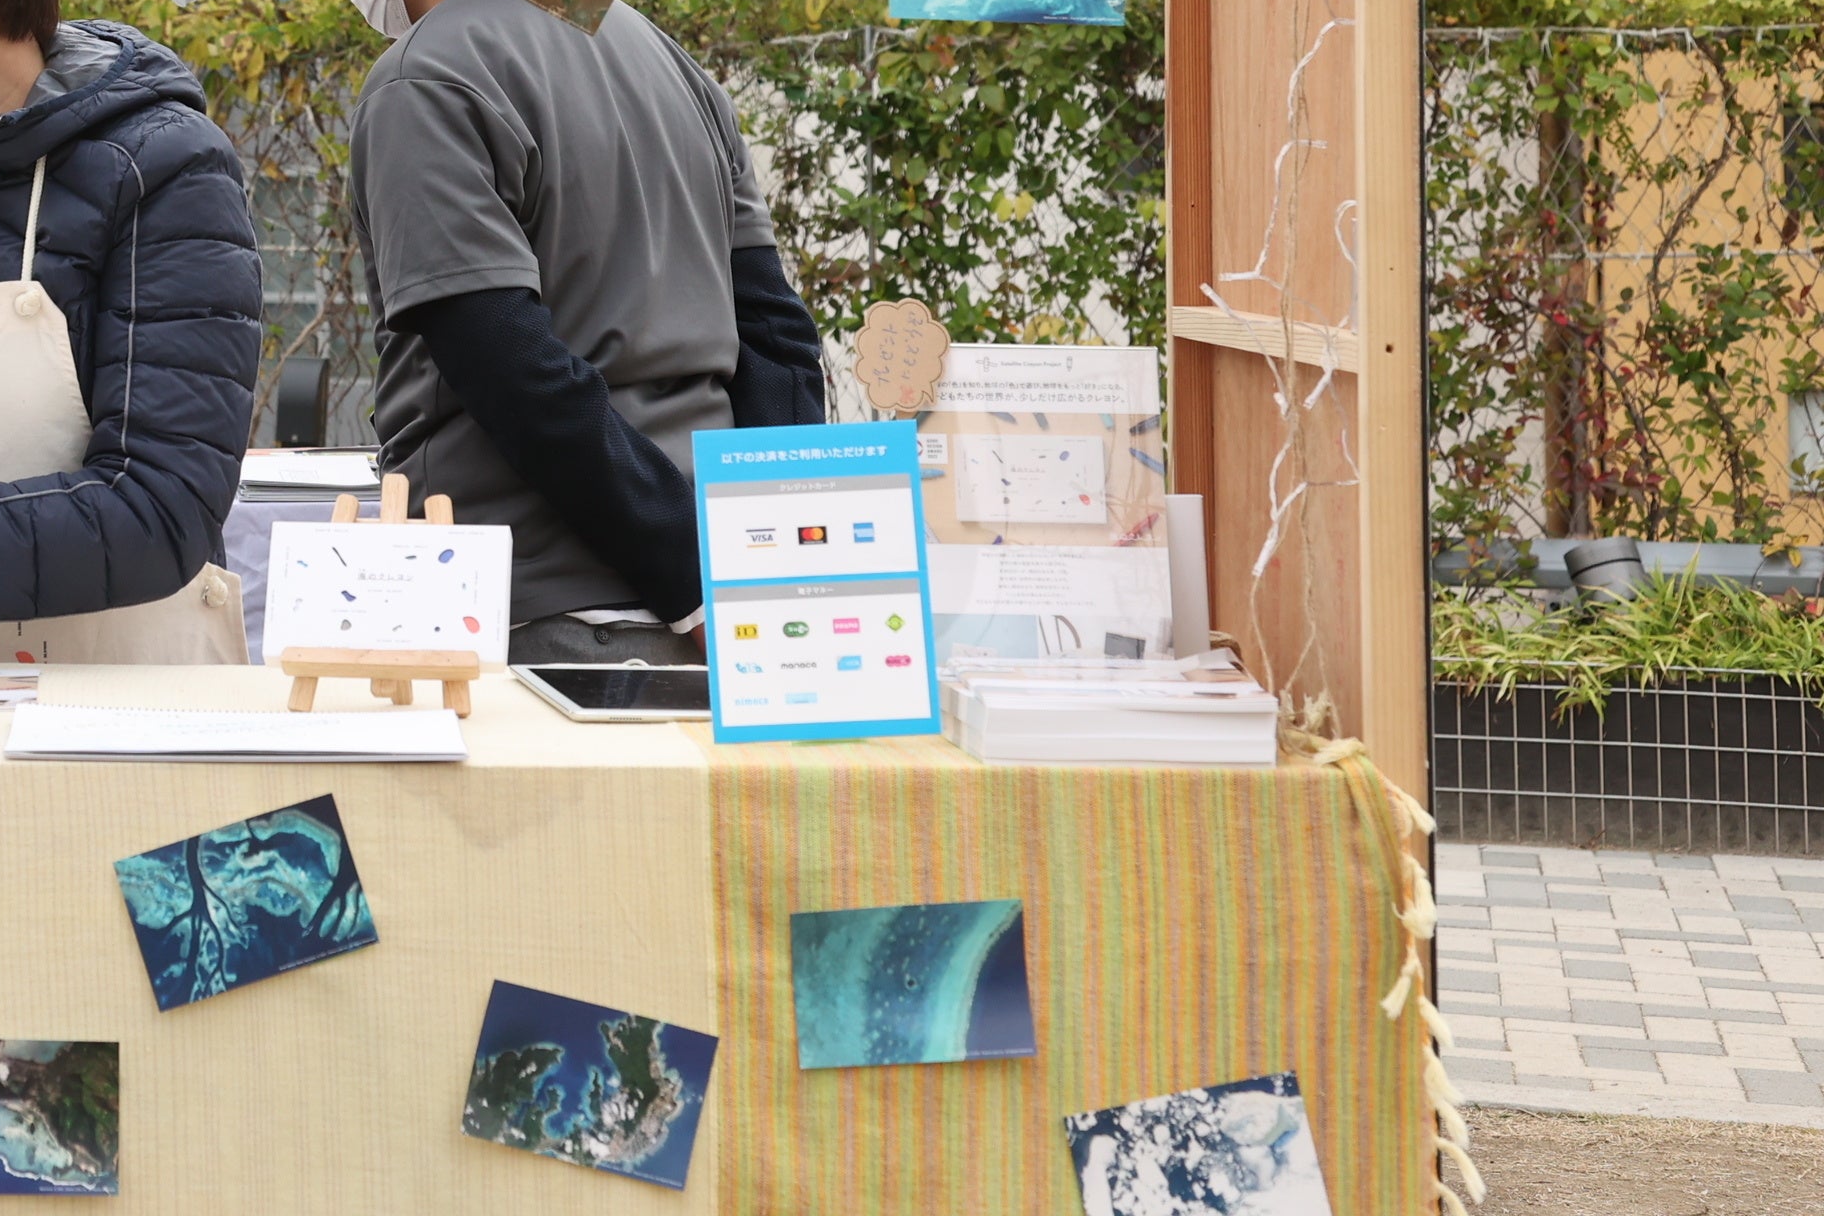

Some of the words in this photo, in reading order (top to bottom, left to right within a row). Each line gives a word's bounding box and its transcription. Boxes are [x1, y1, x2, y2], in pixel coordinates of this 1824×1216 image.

[721, 445, 888, 465] 以下の決済をご利用いただけます
[779, 481, 837, 492] クレジットカード
[750, 533, 774, 543] VISA
[797, 586, 836, 596] 電子マネー
